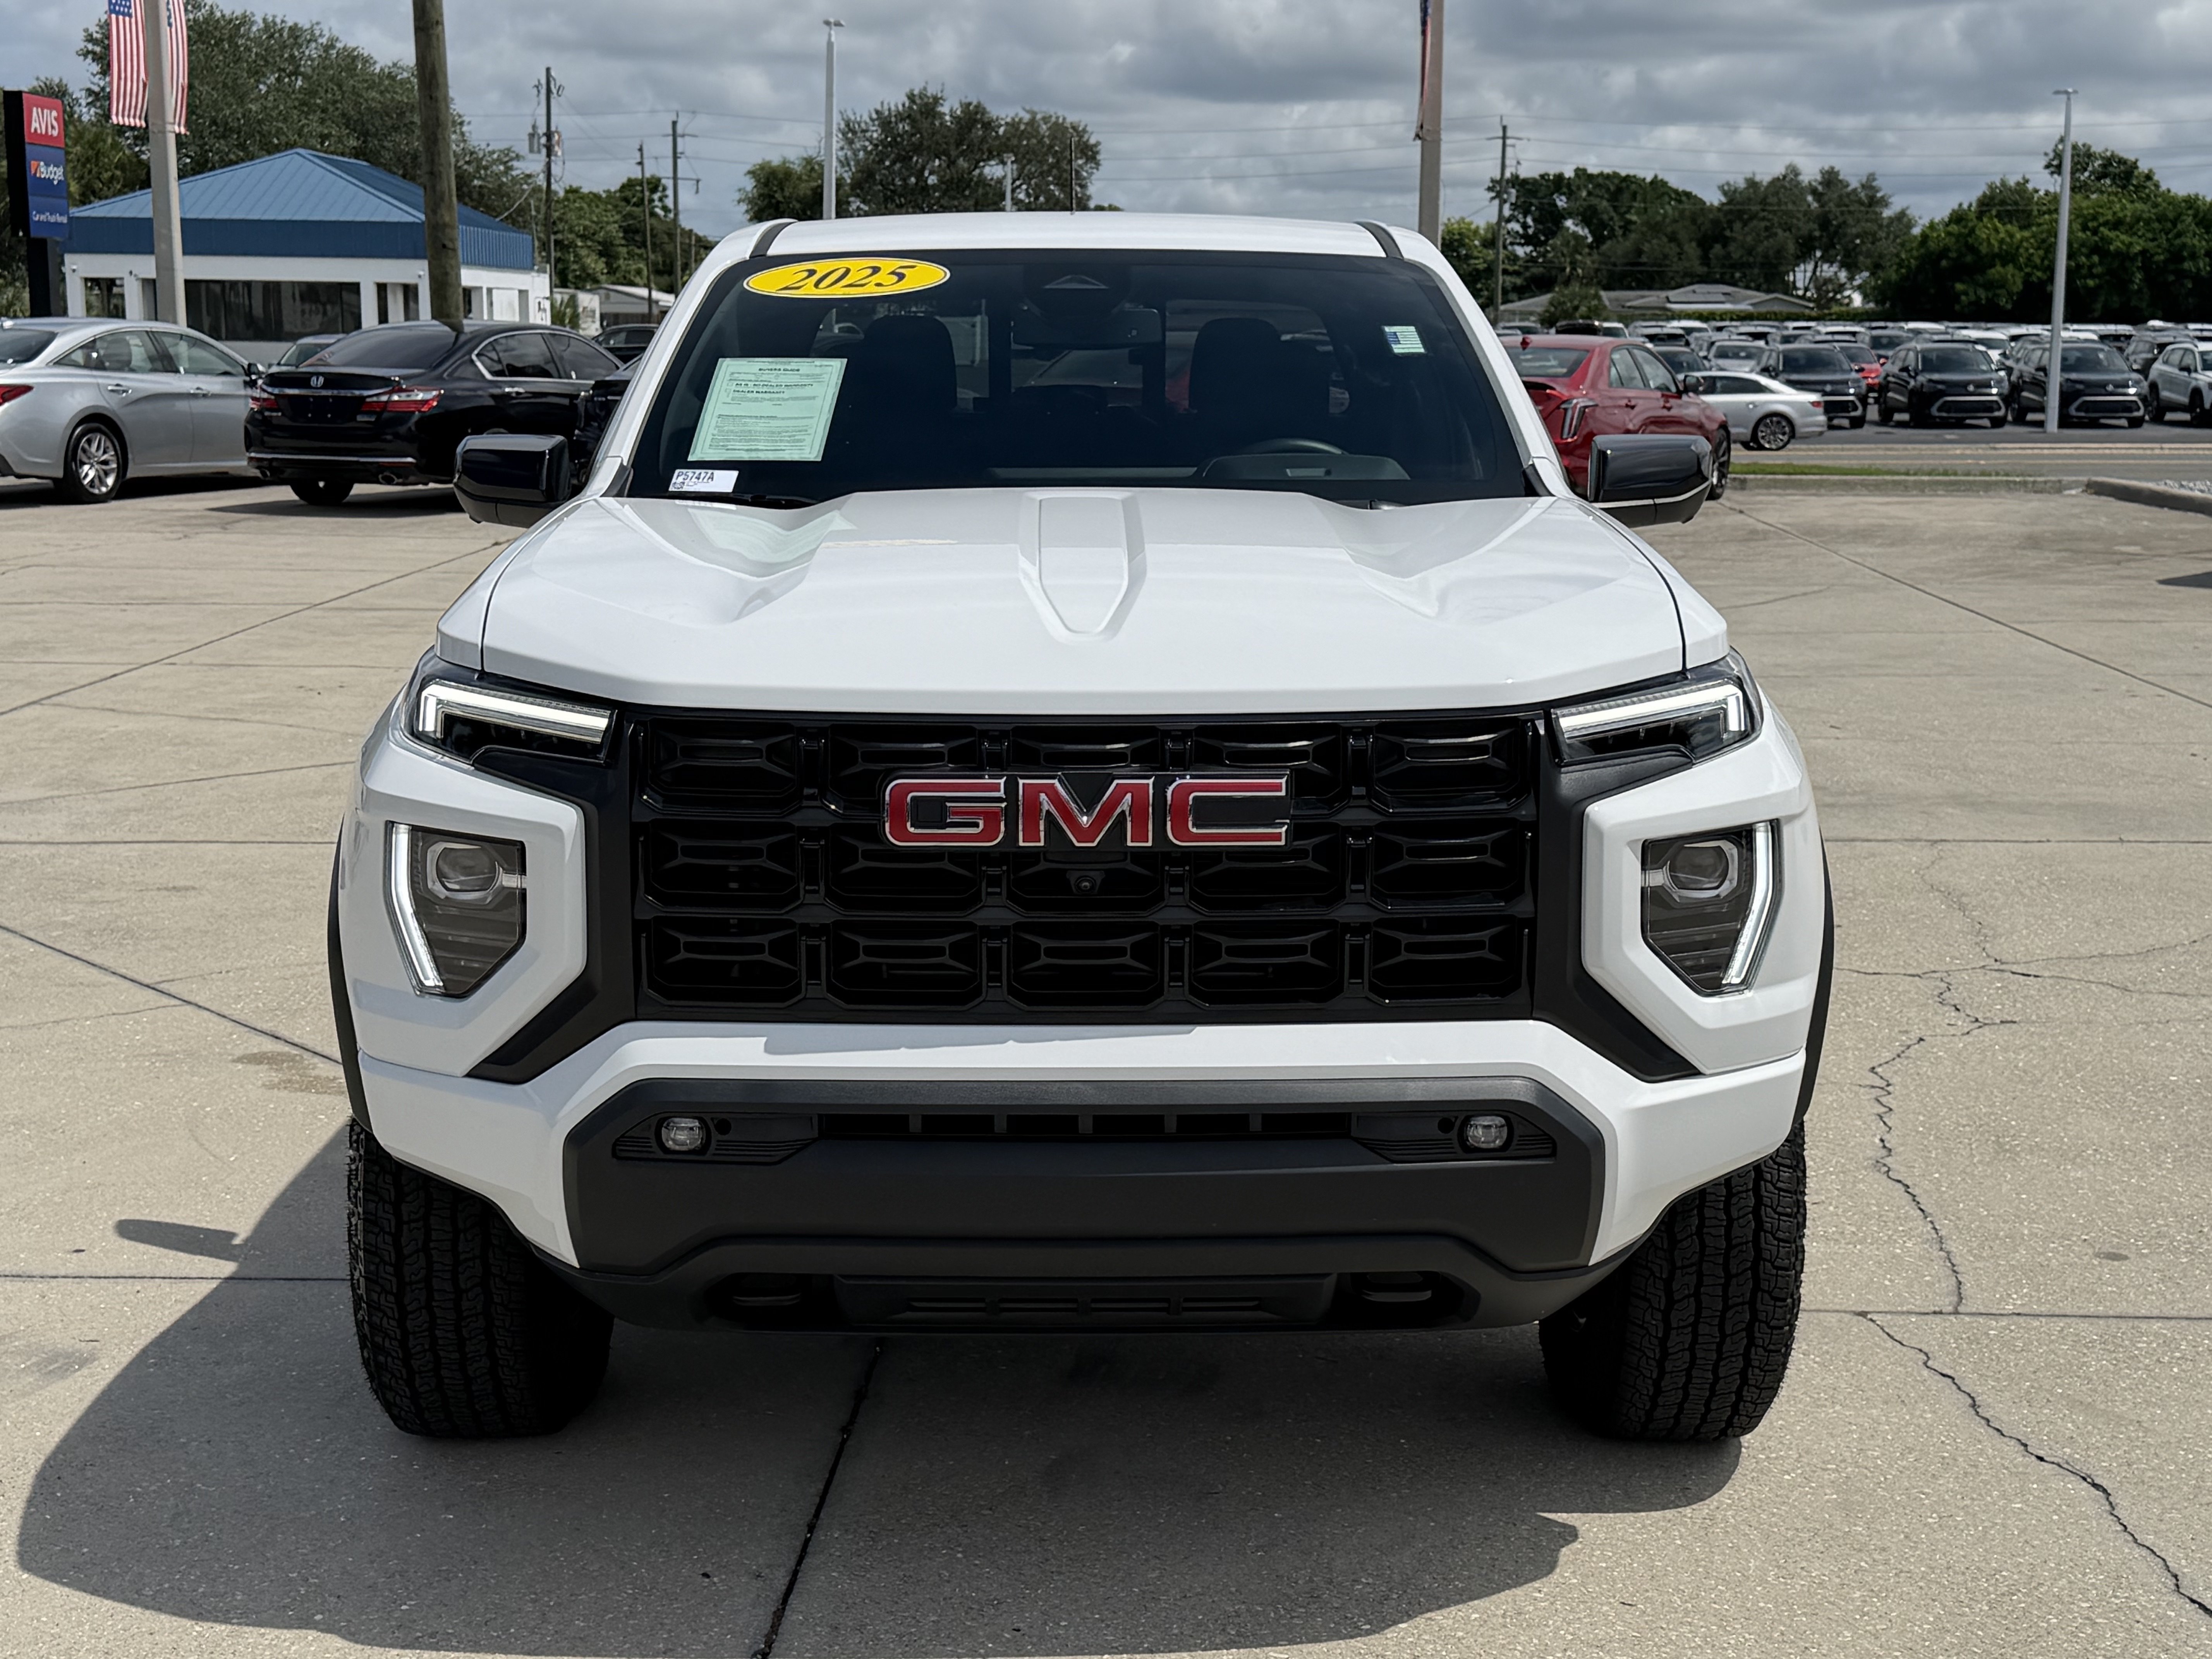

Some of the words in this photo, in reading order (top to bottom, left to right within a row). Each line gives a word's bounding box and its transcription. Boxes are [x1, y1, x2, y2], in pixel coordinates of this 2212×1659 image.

[31, 107, 58, 137] AVIS
[40, 161, 64, 185] Budget
[775, 265, 917, 291] 2025
[676, 471, 714, 482] P5747A
[885, 776, 1289, 847] GMC
